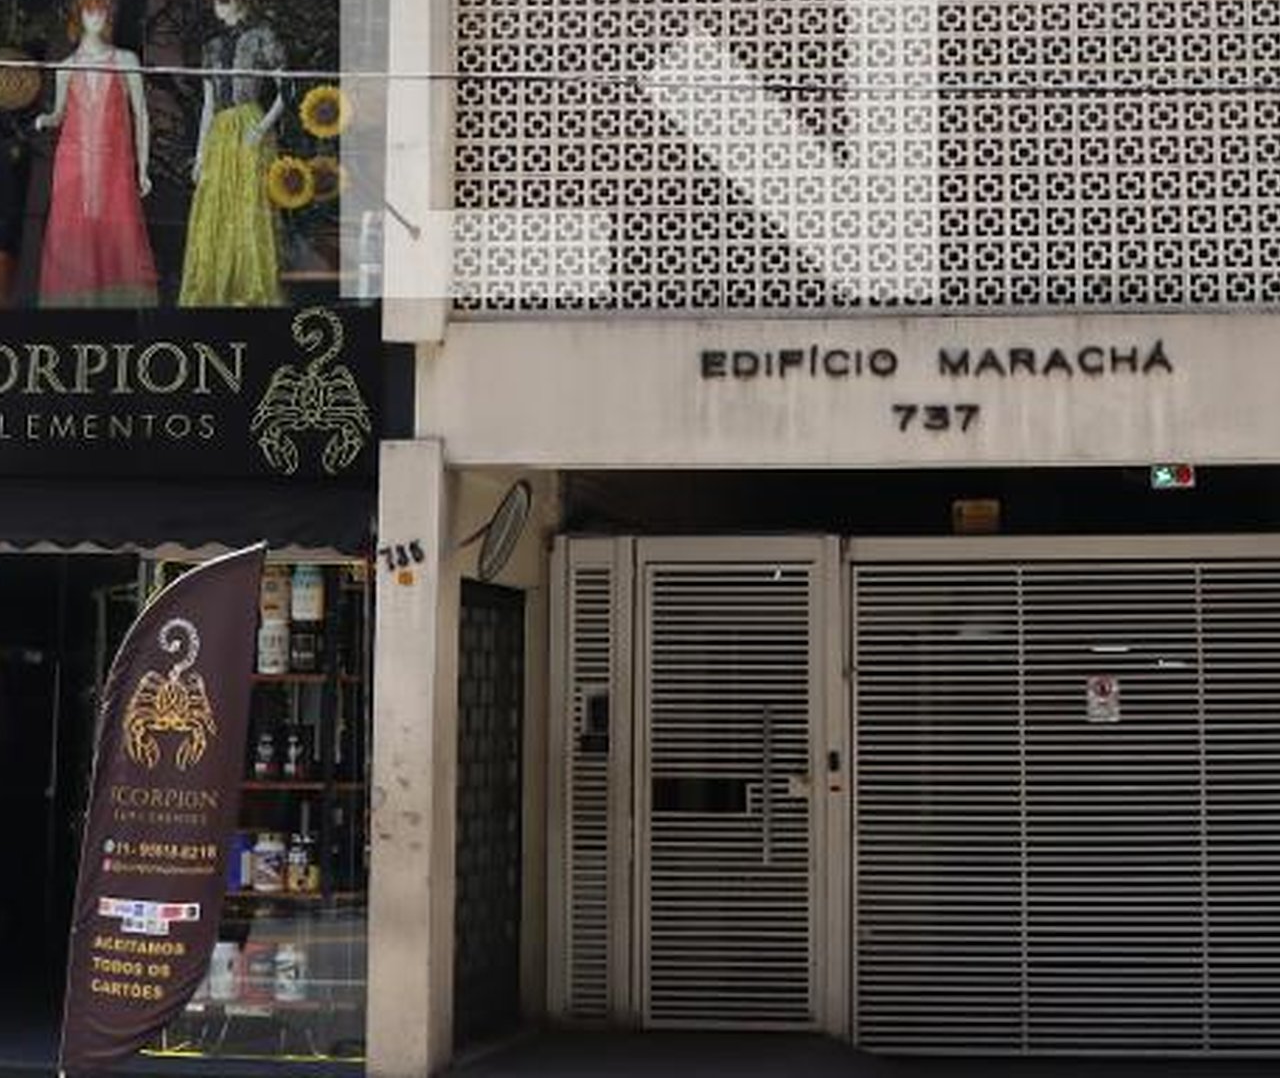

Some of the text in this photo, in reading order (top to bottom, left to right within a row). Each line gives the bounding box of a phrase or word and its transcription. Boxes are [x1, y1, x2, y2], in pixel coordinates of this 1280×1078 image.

[700, 340, 1173, 378] EDIFÍCIO MARACHÁ
[891, 403, 981, 432] 737
[95, 936, 186, 956] ACEITAMOS
[92, 956, 144, 977] TODOS
